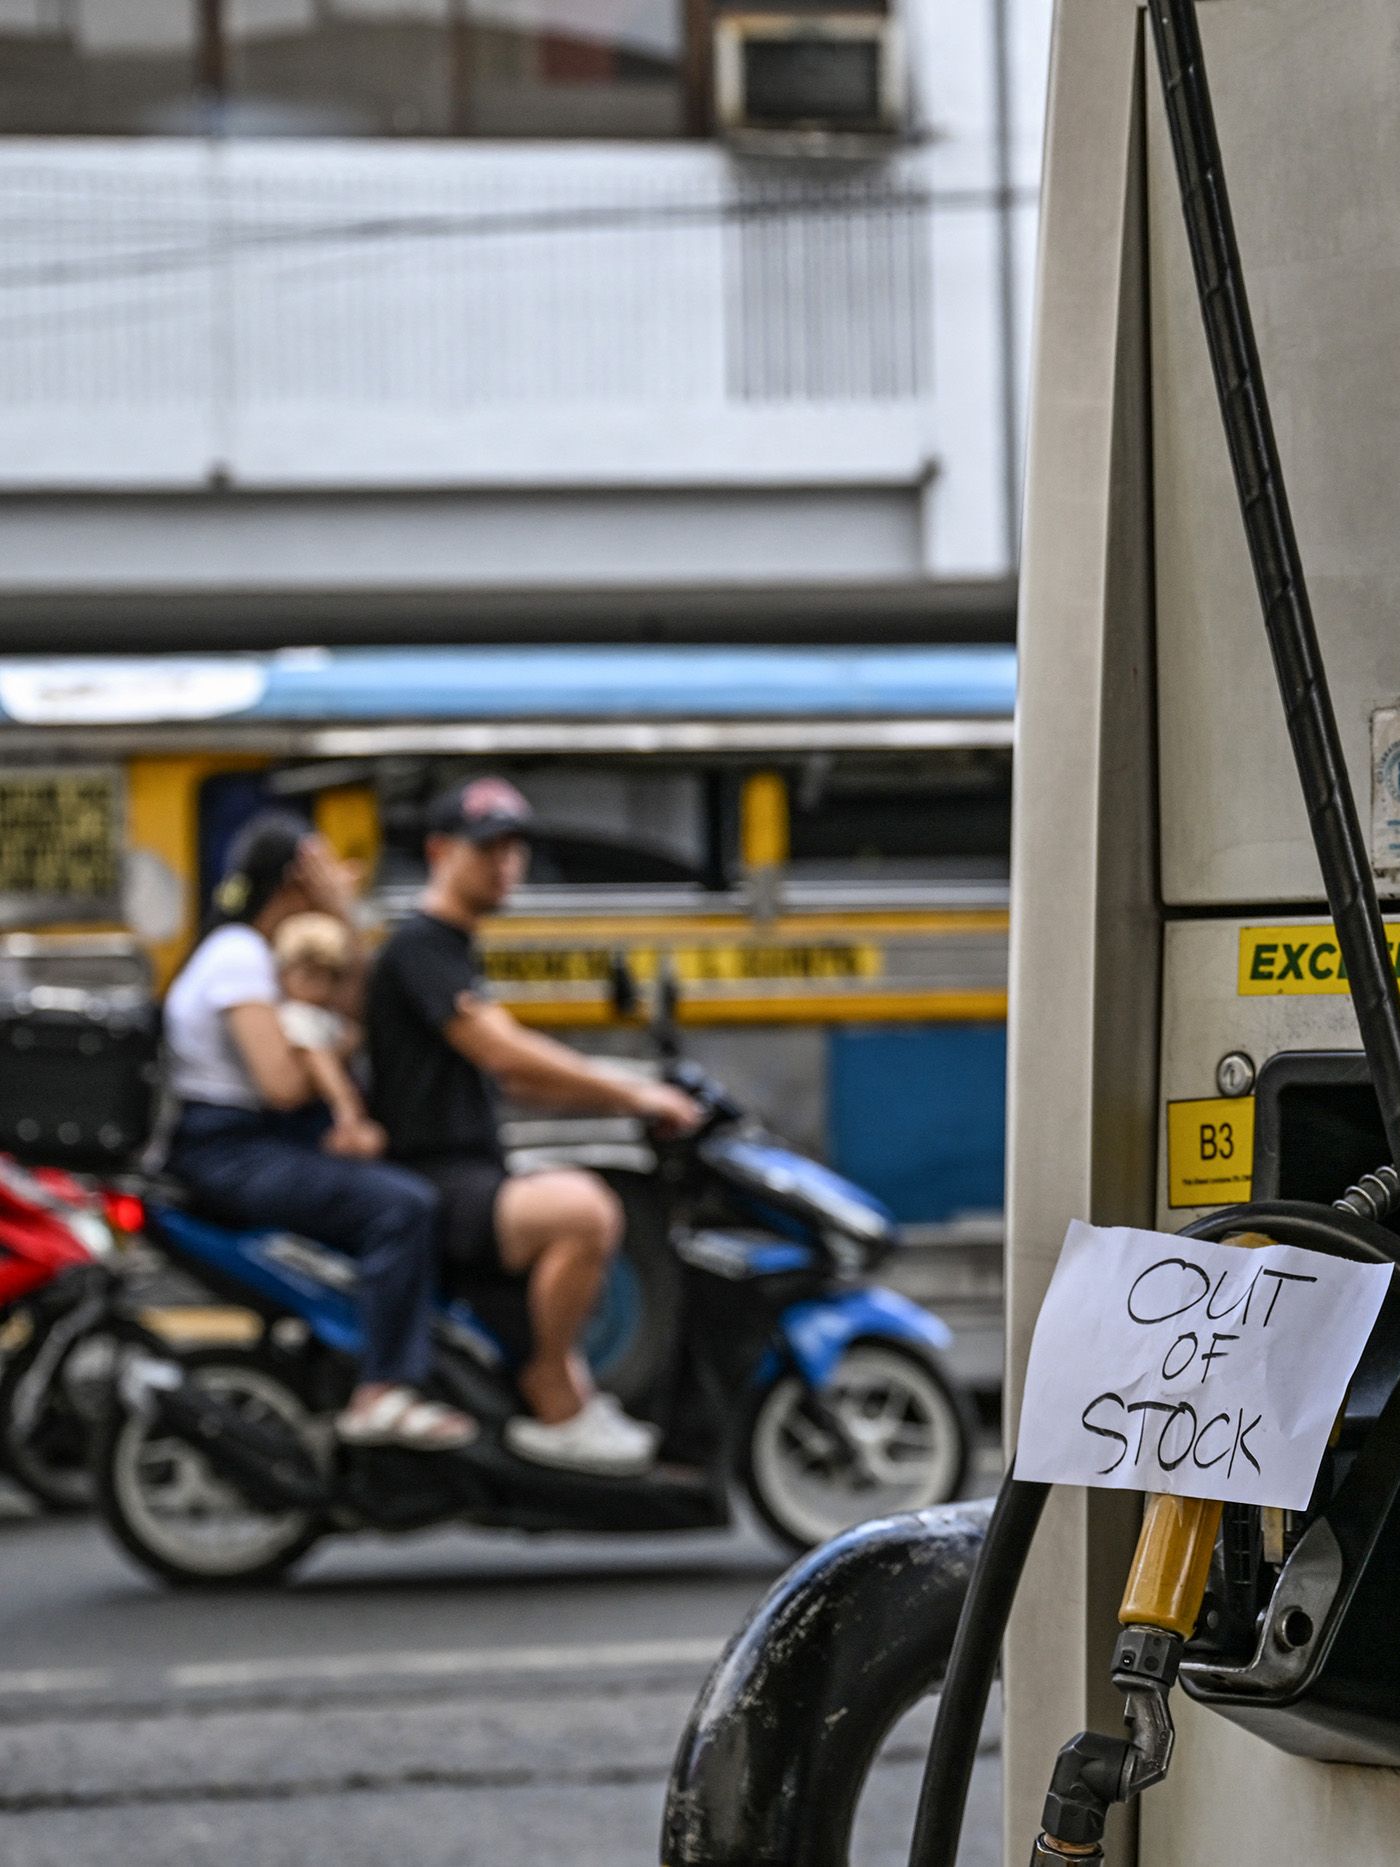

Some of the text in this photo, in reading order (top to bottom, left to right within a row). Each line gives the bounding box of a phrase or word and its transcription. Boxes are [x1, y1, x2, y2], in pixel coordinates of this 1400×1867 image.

[1200, 1122, 1234, 1160] B3
[1127, 1257, 1318, 1327] OUT
[1162, 1331, 1240, 1384] OF
[1081, 1391, 1263, 1479] STOCK
